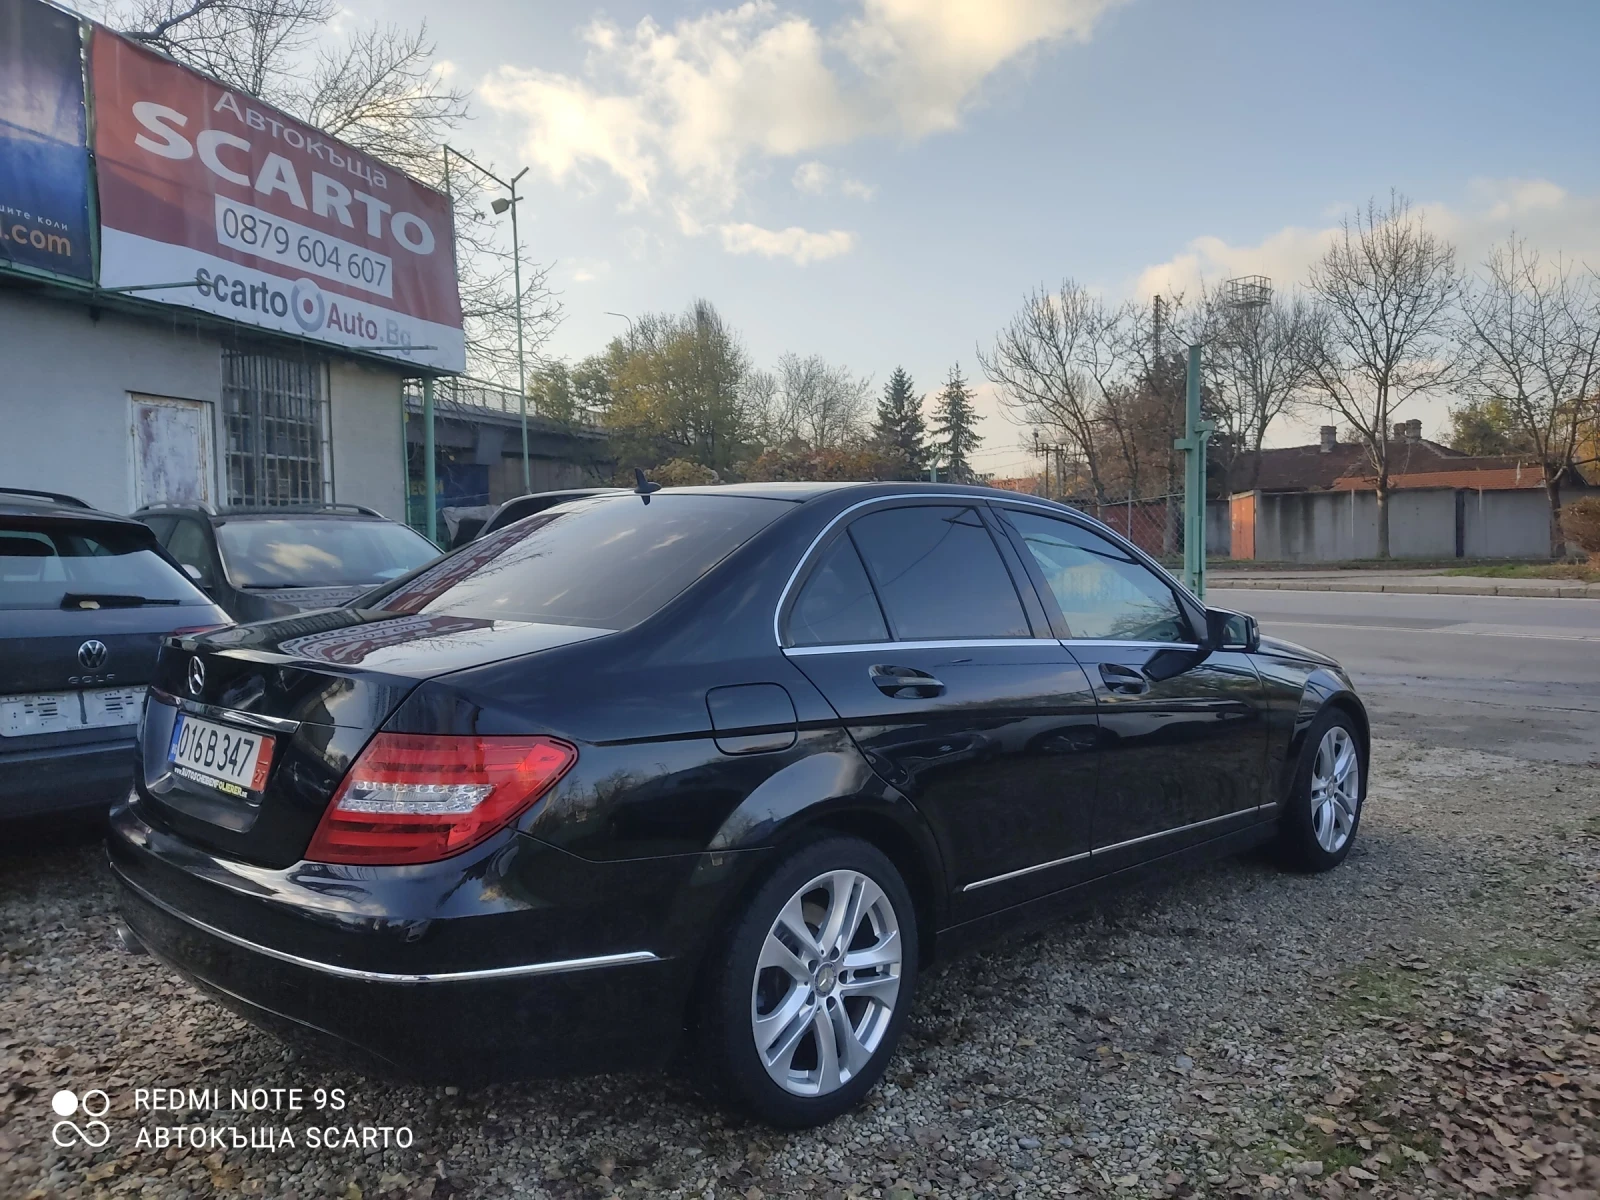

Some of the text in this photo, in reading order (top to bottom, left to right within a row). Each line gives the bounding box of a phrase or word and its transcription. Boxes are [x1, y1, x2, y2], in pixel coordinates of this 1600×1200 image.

[214, 91, 387, 189] Автокъща
[132, 101, 435, 255] SCARTO
[0, 224, 71, 257] .com
[38, 216, 68, 231] коли
[222, 207, 387, 288] 0879 604 607
[196, 267, 288, 318] scarto
